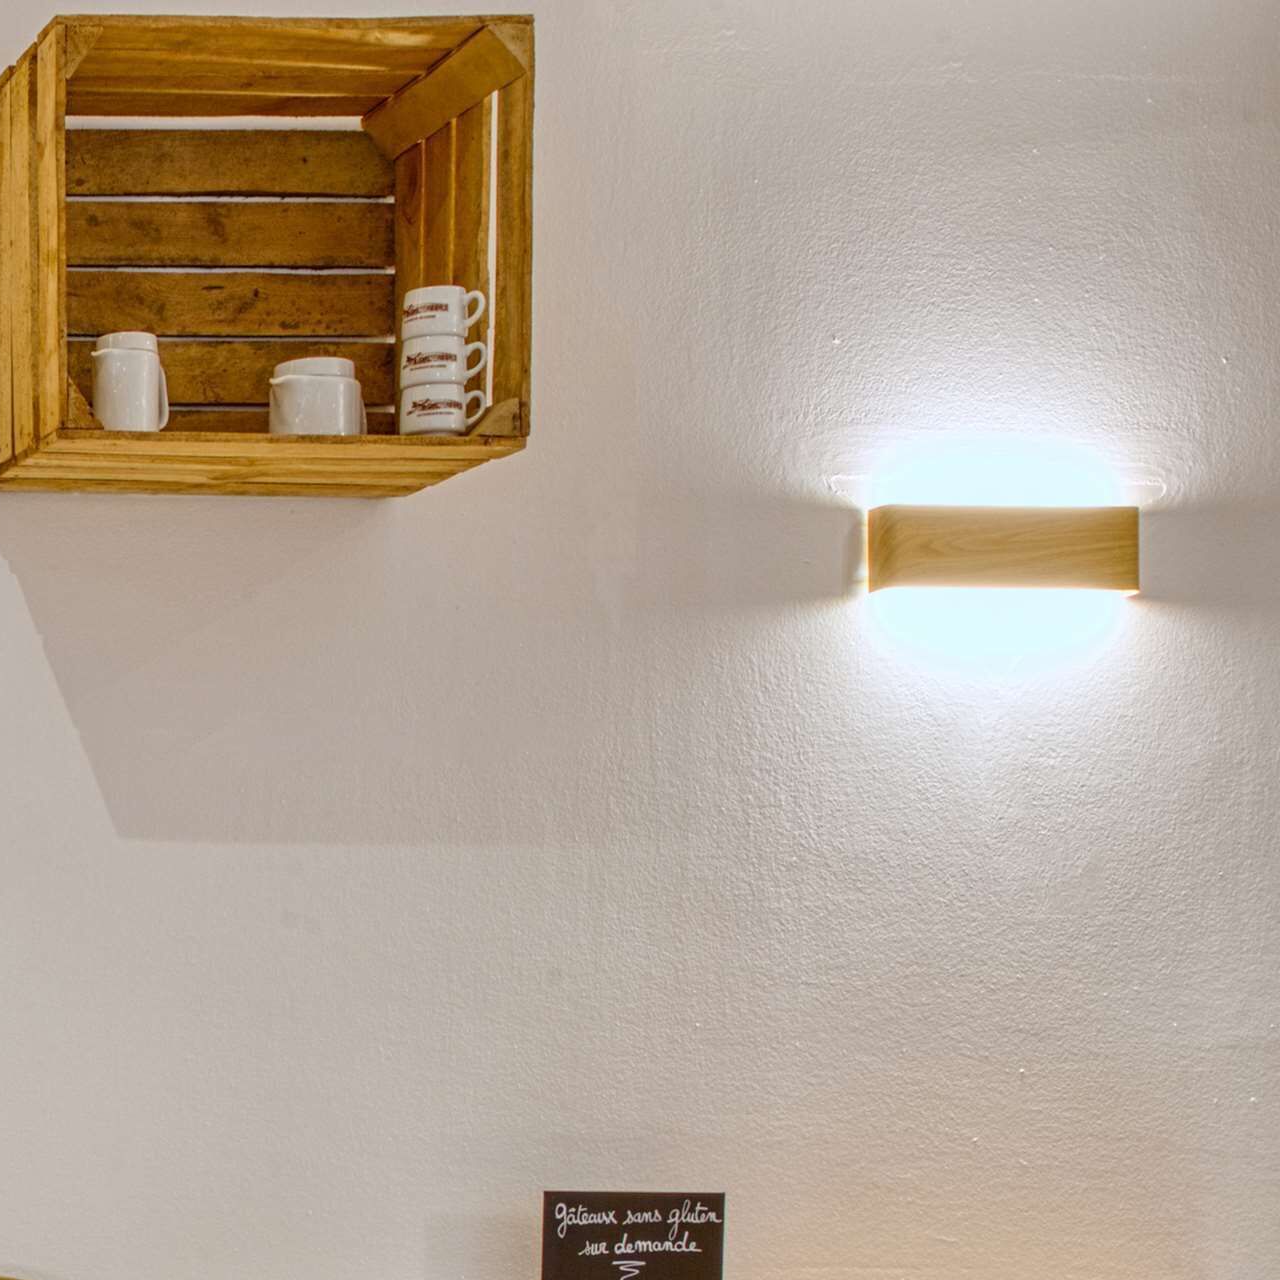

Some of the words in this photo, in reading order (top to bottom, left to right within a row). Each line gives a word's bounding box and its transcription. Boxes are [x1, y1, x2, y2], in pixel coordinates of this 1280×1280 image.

[622, 1208, 662, 1225] sans
[667, 1199, 723, 1240] gluten
[578, 1239, 609, 1256] sur
[614, 1231, 702, 1254] demande
